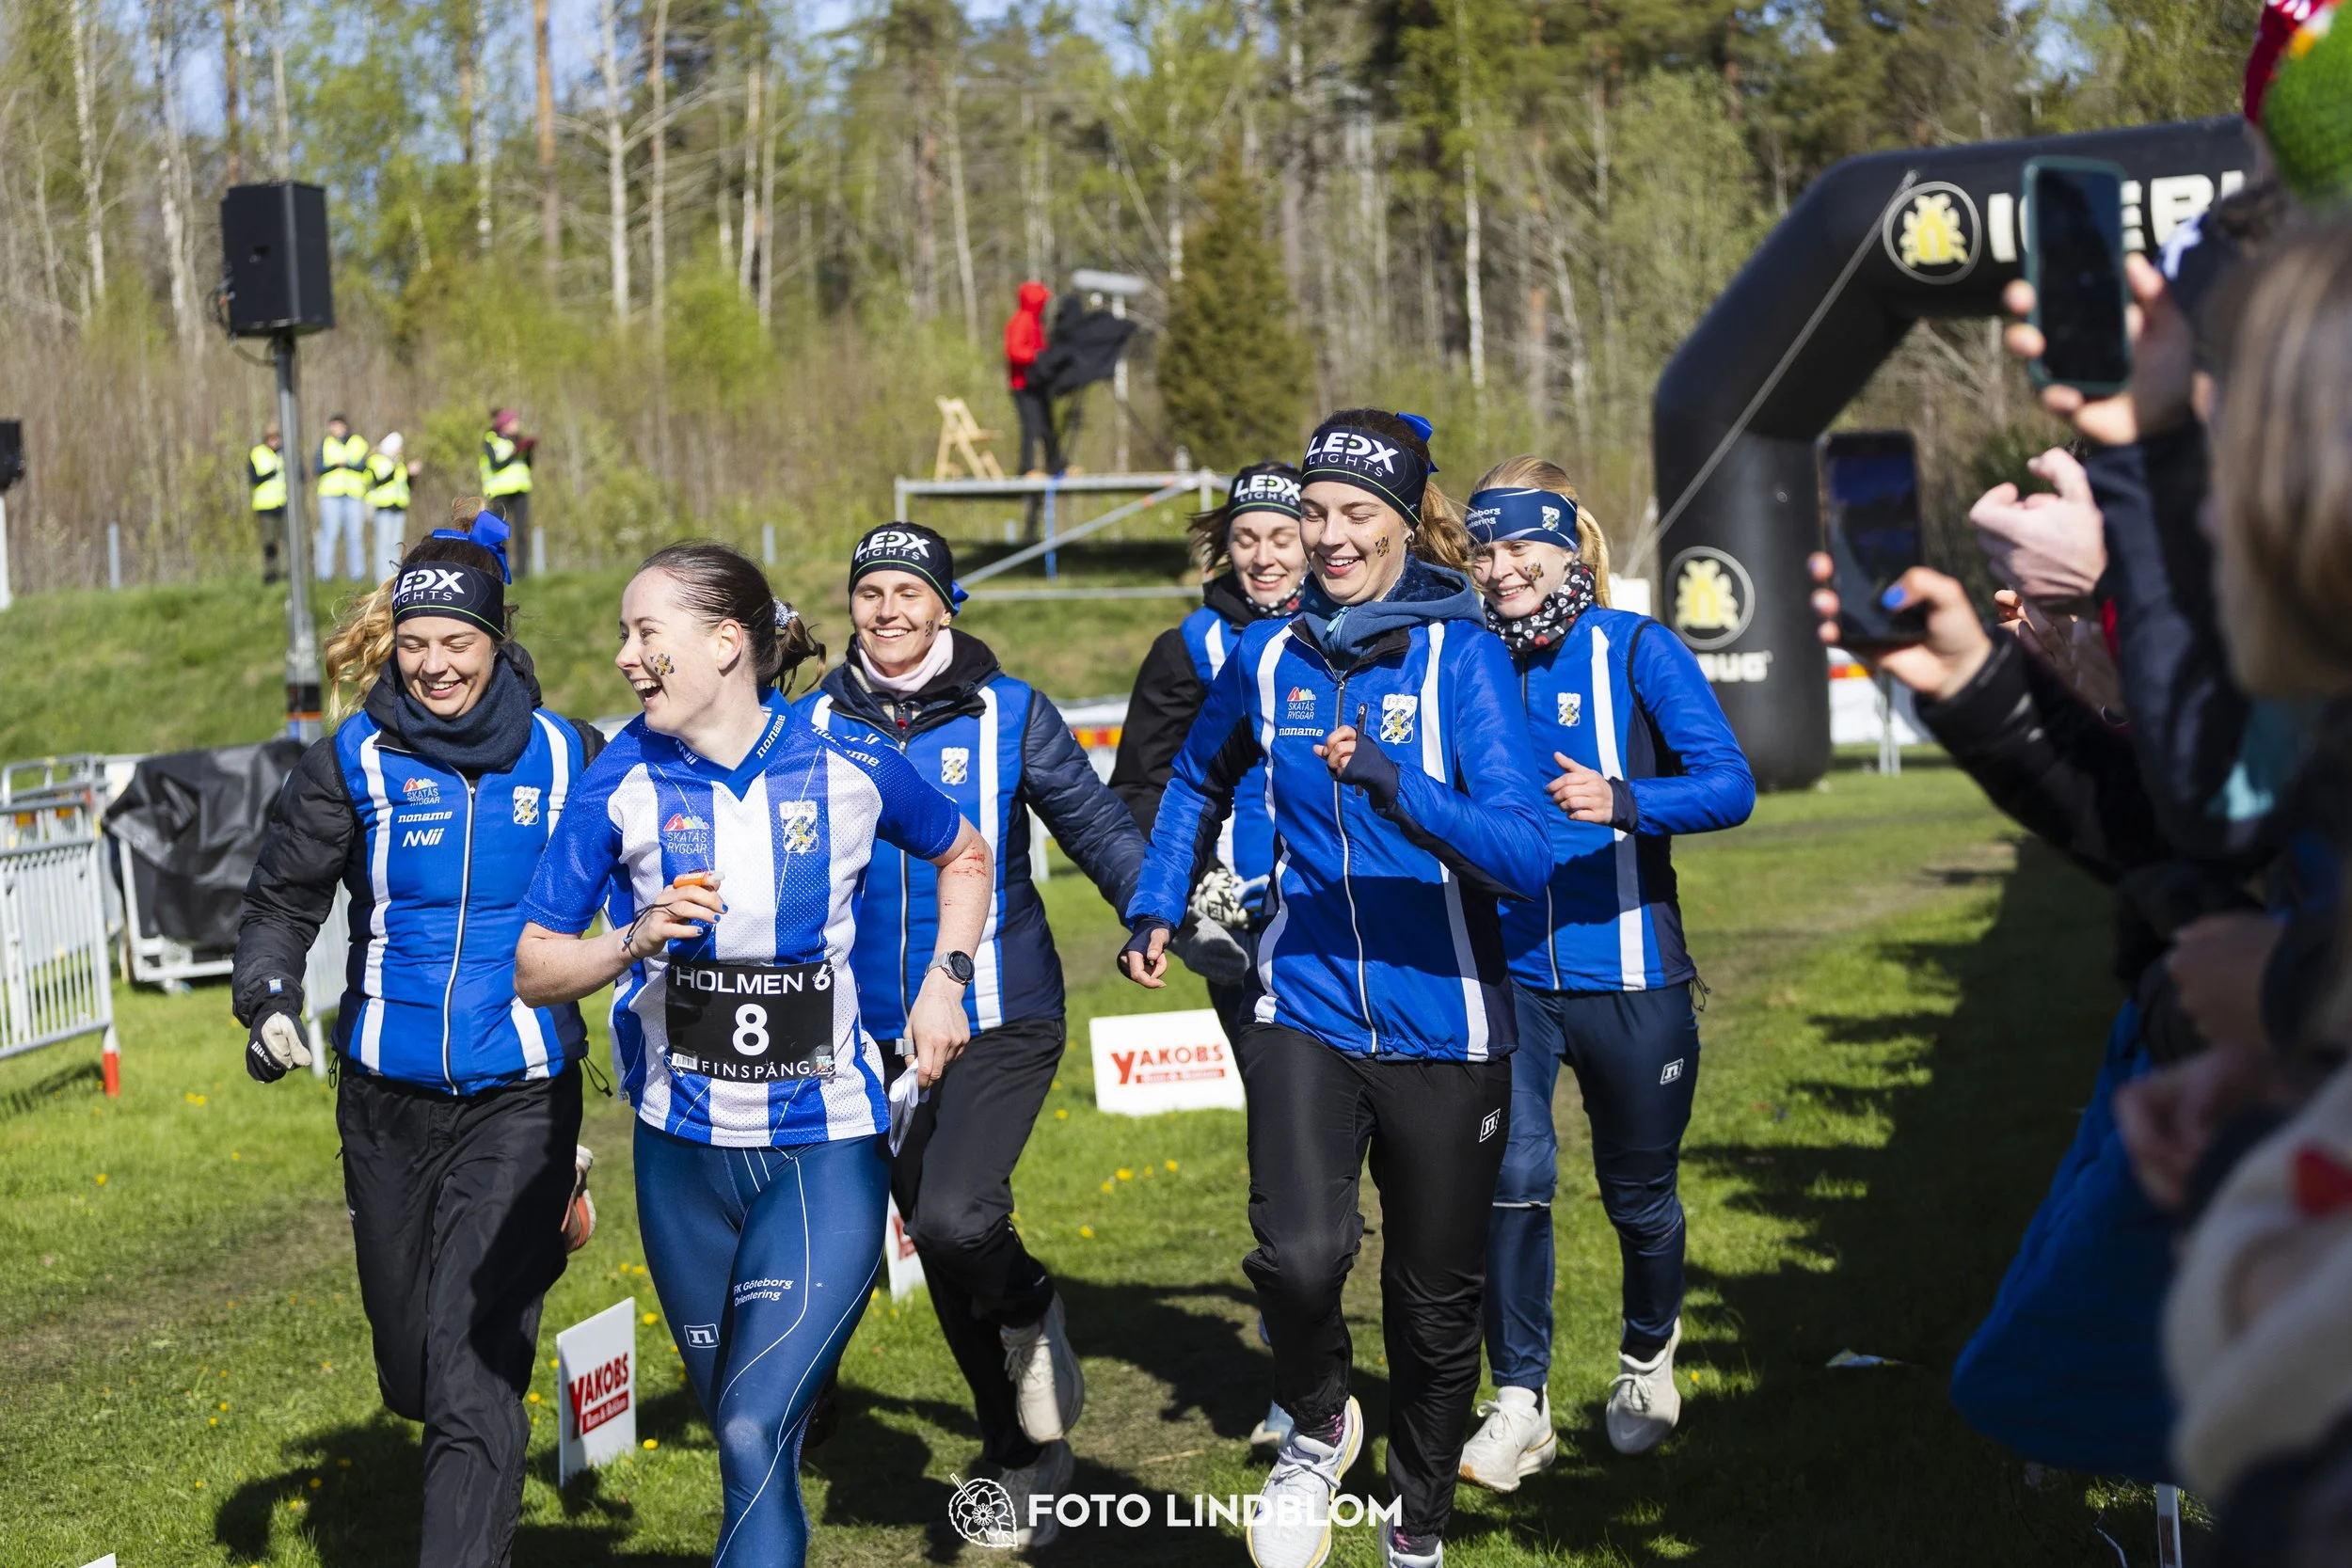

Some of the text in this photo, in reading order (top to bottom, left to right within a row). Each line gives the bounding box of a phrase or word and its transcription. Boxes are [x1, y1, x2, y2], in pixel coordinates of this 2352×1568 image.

[1305, 433, 1399, 474] LEDX
[1309, 453, 1384, 478] LIGHTS
[1234, 474, 1301, 502] LEDX
[1240, 491, 1297, 507] LIGHTS
[854, 531, 930, 561] LEDX
[858, 547, 920, 563] LIGHTS
[392, 569, 465, 603] LEDX
[394, 591, 453, 610] LIGHTS
[1288, 701, 1315, 711] SKATÅS
[1287, 711, 1314, 721] RYGGAR
[756, 714, 786, 759] noname
[1279, 727, 1325, 736] noname
[406, 787, 439, 800] SKATÅS
[398, 811, 453, 823] noname
[666, 830, 707, 845] SKATÅS
[666, 843, 707, 855] RYGGAR
[675, 963, 831, 995] HOLMEN 6
[732, 1003, 770, 1056] 8
[701, 1061, 810, 1079] FINSPÅNG
[1110, 1044, 1225, 1085] YAKOBS
[743, 1277, 794, 1290] Göteborg
[568, 1351, 629, 1440] YAKOBS
